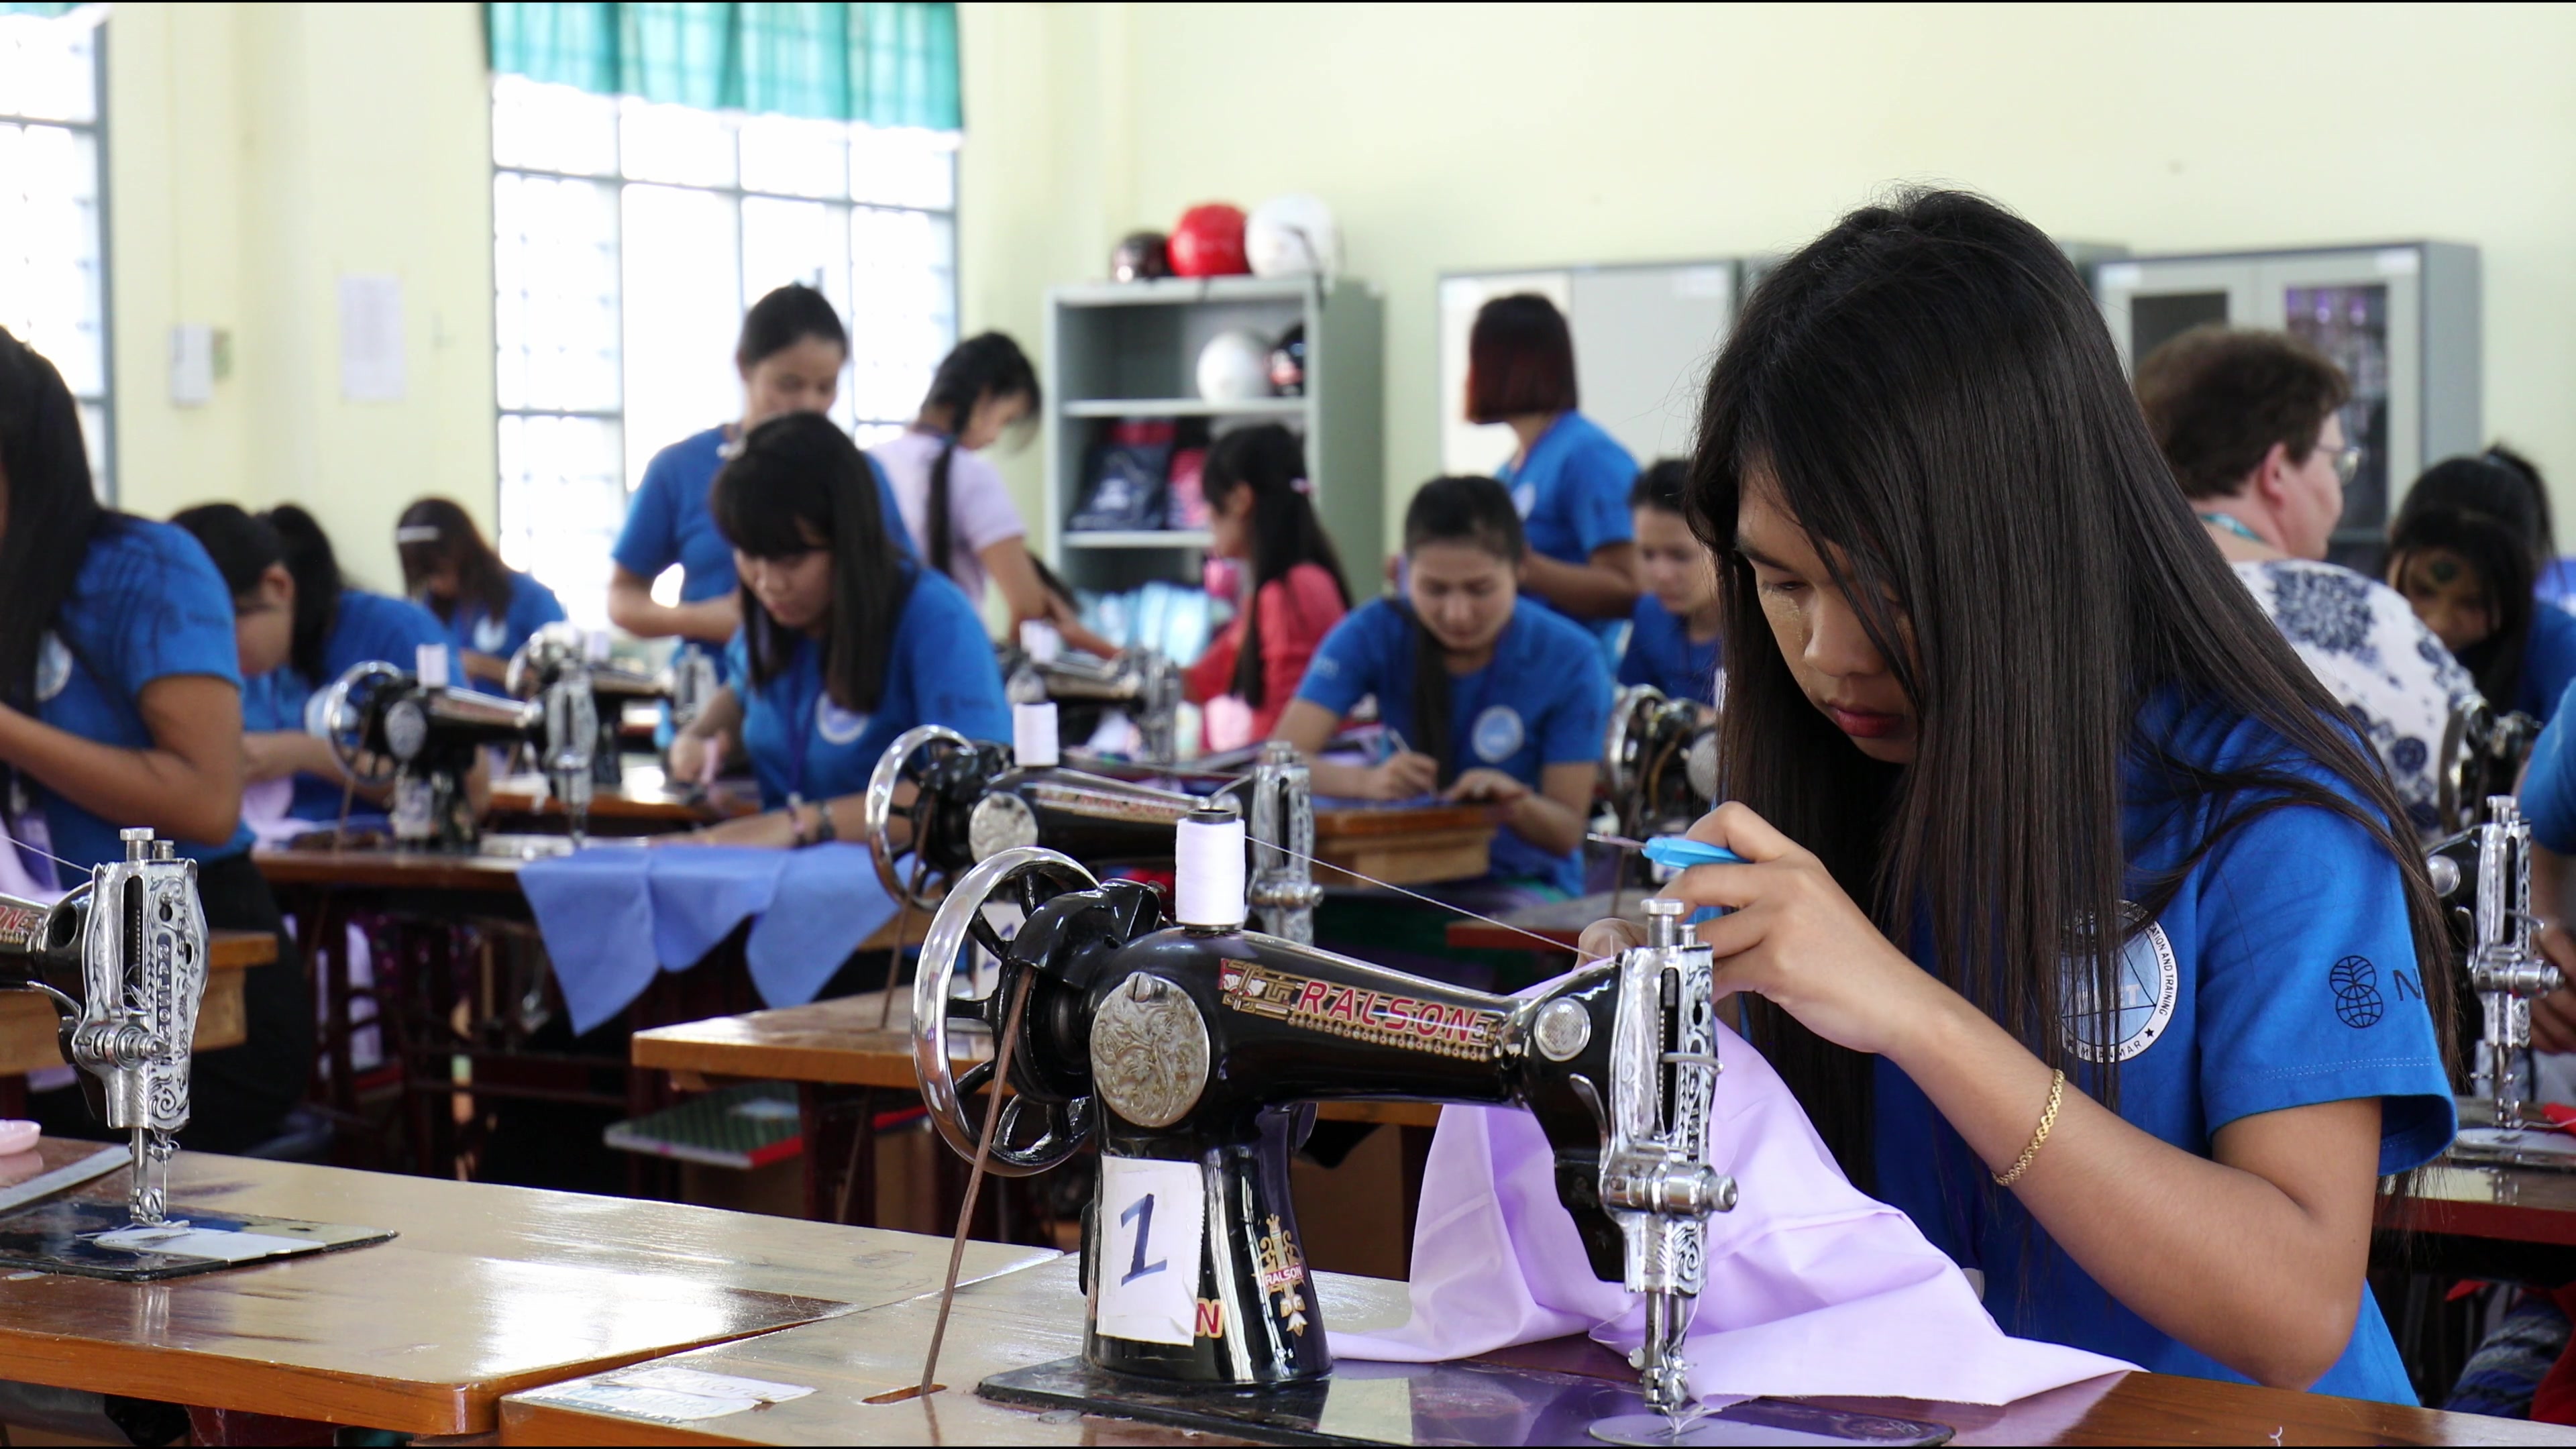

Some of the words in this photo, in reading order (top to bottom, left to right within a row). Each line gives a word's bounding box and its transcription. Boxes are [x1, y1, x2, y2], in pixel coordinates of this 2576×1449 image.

[2161, 953, 2174, 972] AND
[2159, 974, 2175, 1017] TRAINING
[1297, 980, 1480, 1044] RALSON
[2080, 1040, 2142, 1059] MMAR
[1120, 1193, 1168, 1288] 1
[1265, 1267, 1303, 1287] RALSON
